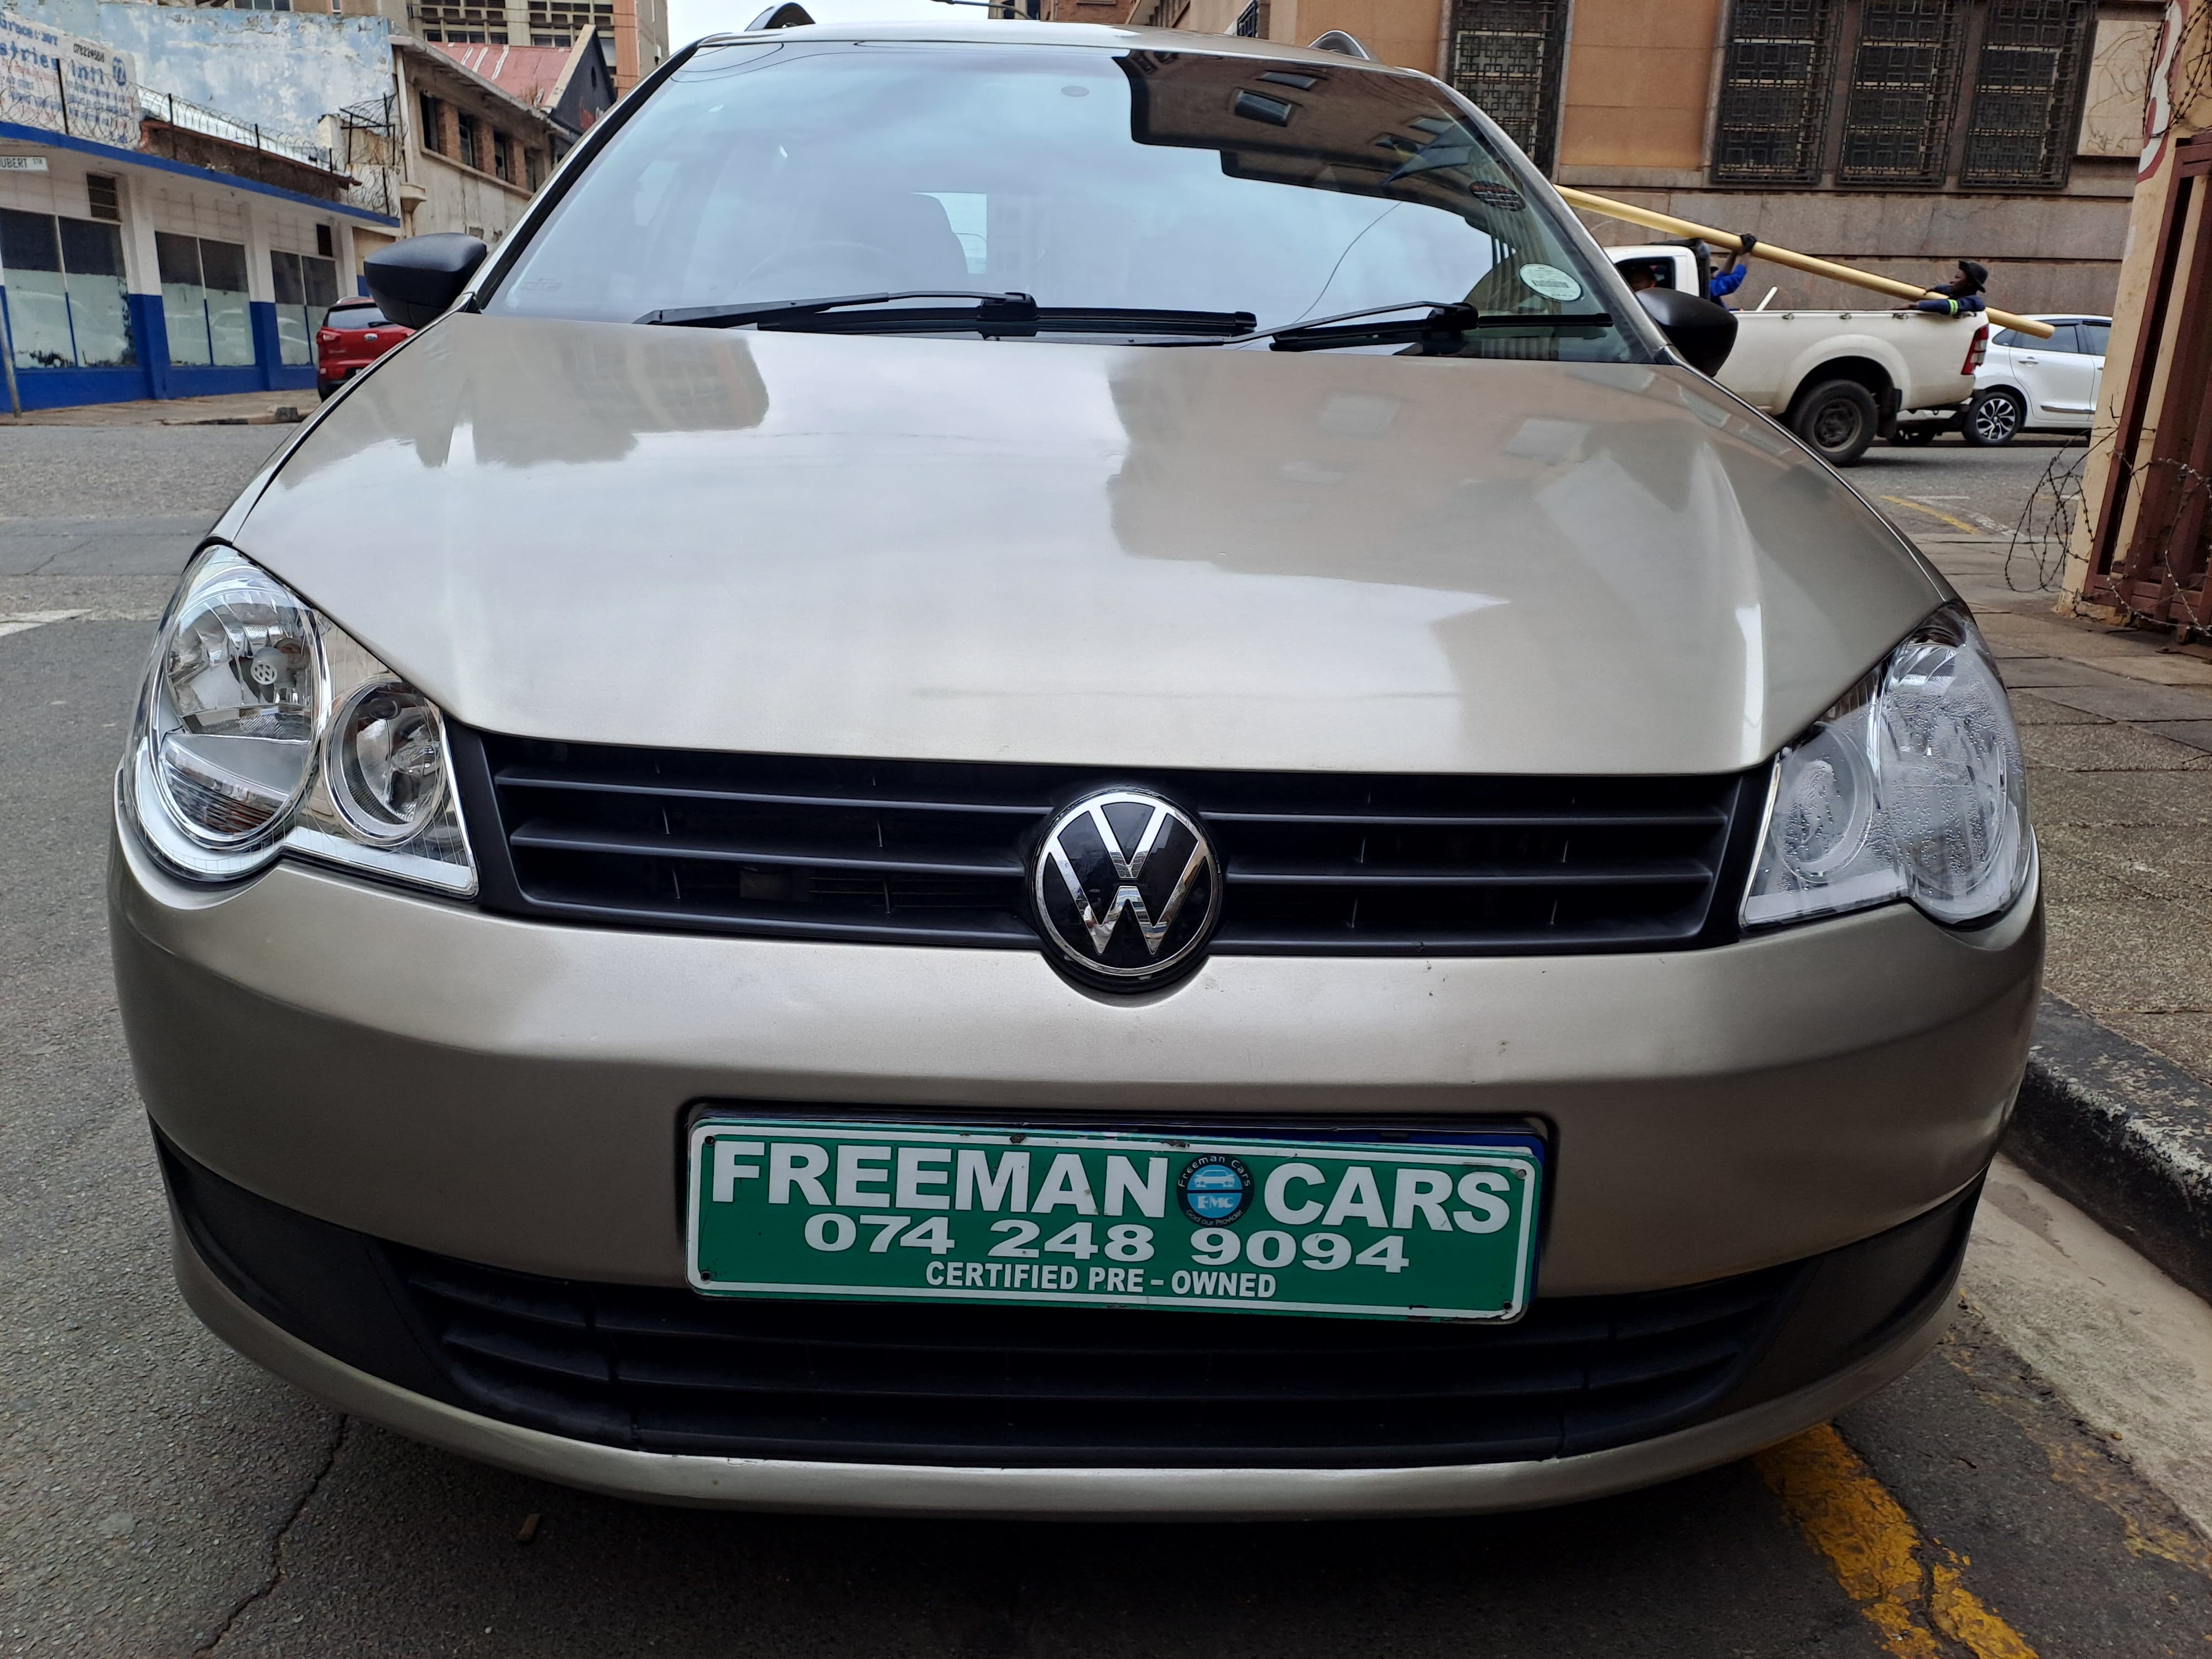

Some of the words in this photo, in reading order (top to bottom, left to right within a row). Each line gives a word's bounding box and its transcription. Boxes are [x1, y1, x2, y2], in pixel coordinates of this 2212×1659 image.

[713, 1141, 1168, 1218] FREEMAN
[1265, 1163, 1510, 1233] CARS
[1177, 1155, 1225, 1187] Freeman
[1231, 1159, 1251, 1187] Cars
[805, 1214, 954, 1254] 074
[989, 1220, 1154, 1261] 248
[1191, 1228, 1409, 1272] 9094
[926, 1261, 1078, 1290] CERTIFIED
[1088, 1267, 1144, 1292] PRE
[1172, 1271, 1276, 1297] OWNED
